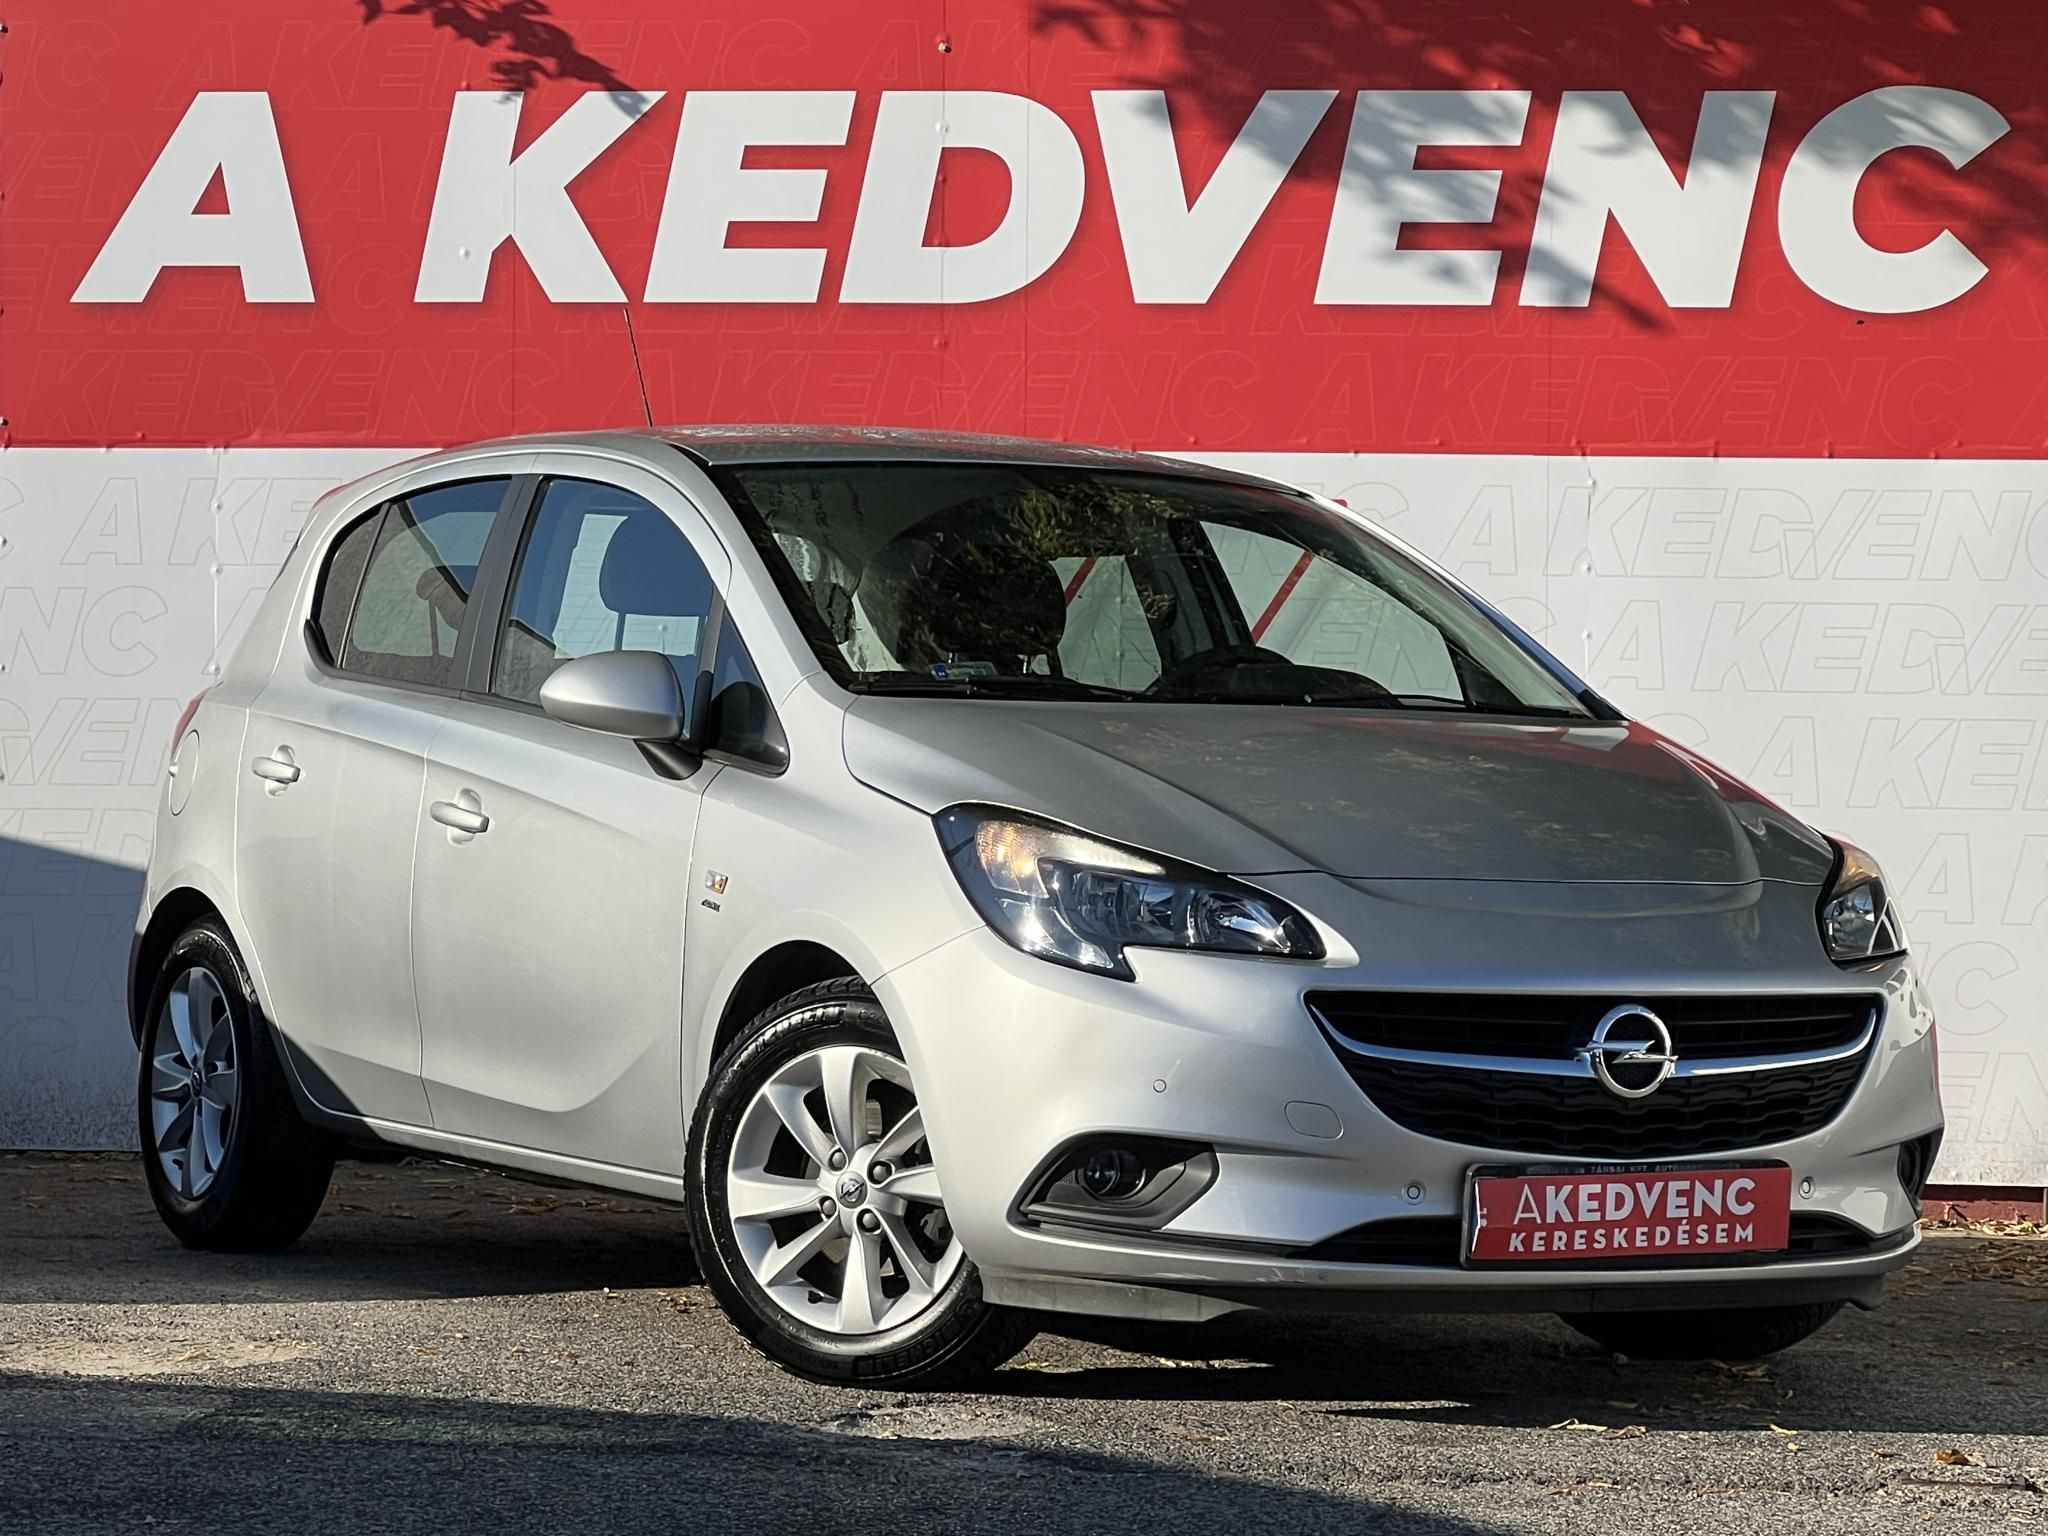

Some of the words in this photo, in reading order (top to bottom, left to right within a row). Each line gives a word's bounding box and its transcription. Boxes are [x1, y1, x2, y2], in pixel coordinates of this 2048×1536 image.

[70, 90, 315, 304] A
[414, 86, 2012, 314] KEDVENC
[1401, 353, 1975, 449] KEDVENC
[60, 477, 143, 566] A
[1437, 484, 1519, 576] A
[1543, 485, 2048, 582] KEDVEN
[1508, 1220, 1755, 1253] KERESKEDÉSEM
